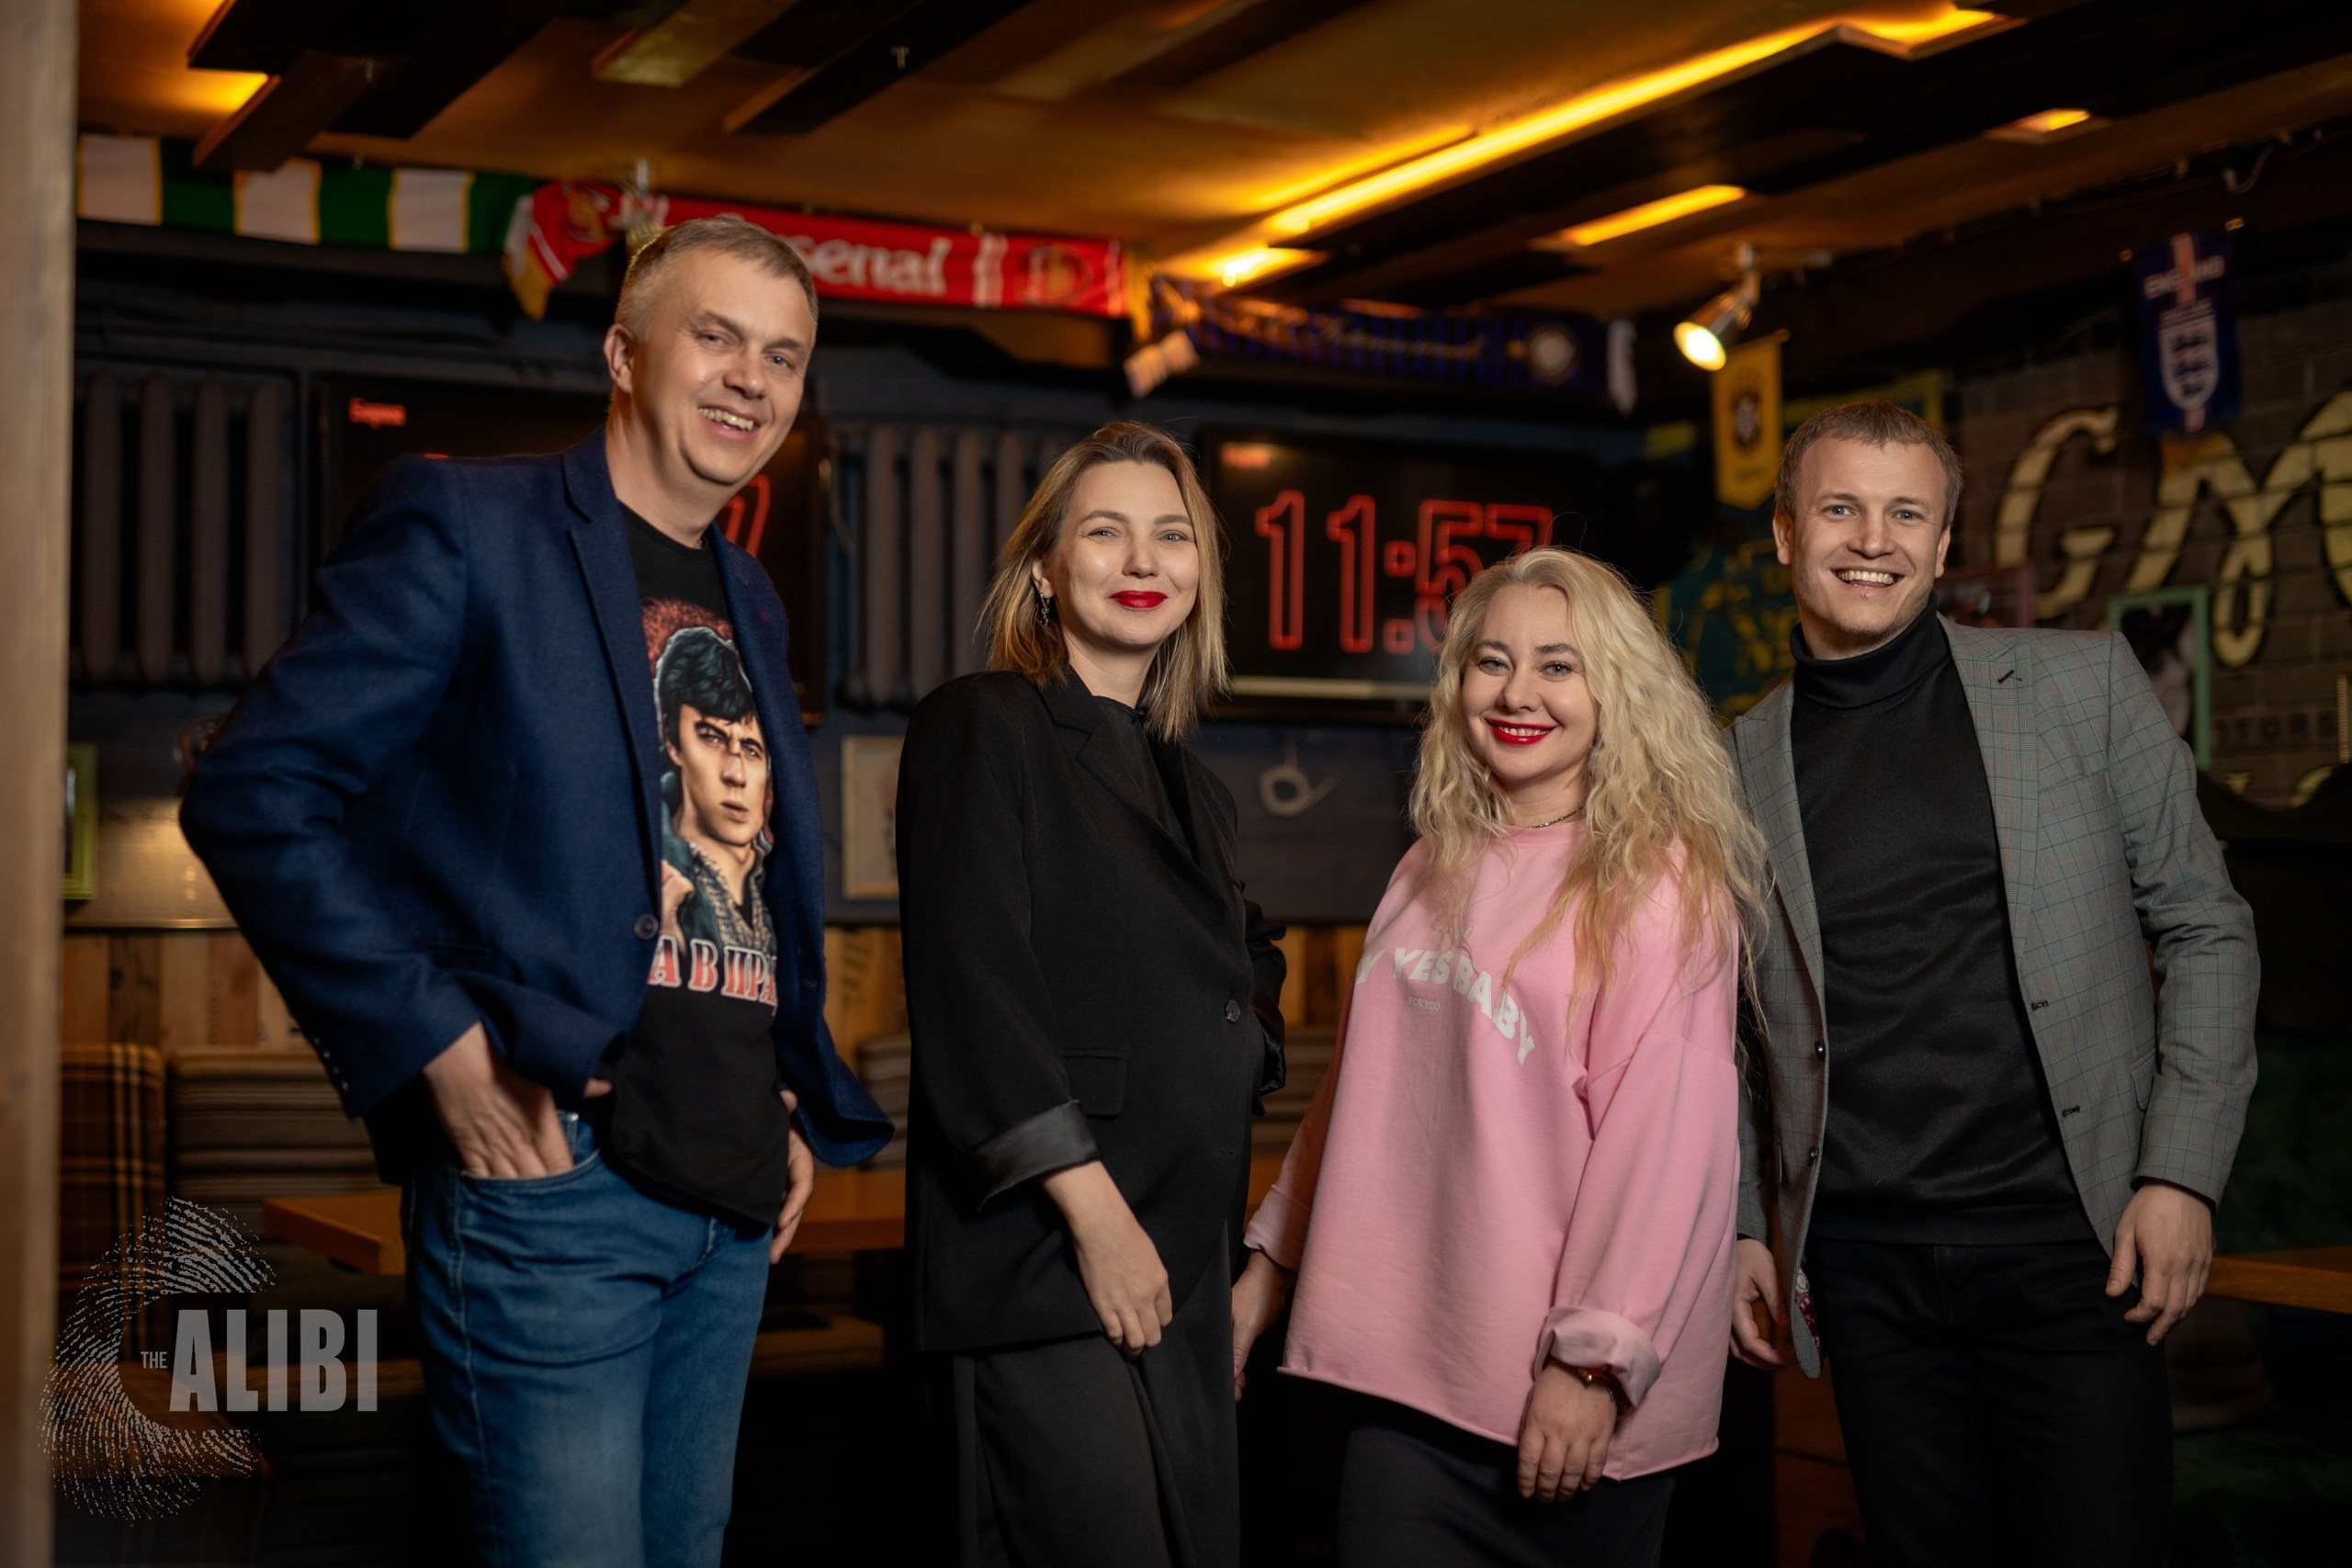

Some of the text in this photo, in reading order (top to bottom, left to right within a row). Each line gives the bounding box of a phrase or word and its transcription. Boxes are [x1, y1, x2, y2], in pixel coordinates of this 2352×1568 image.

[776, 235, 954, 298] senal
[1408, 993, 1441, 1012] FOR YOU
